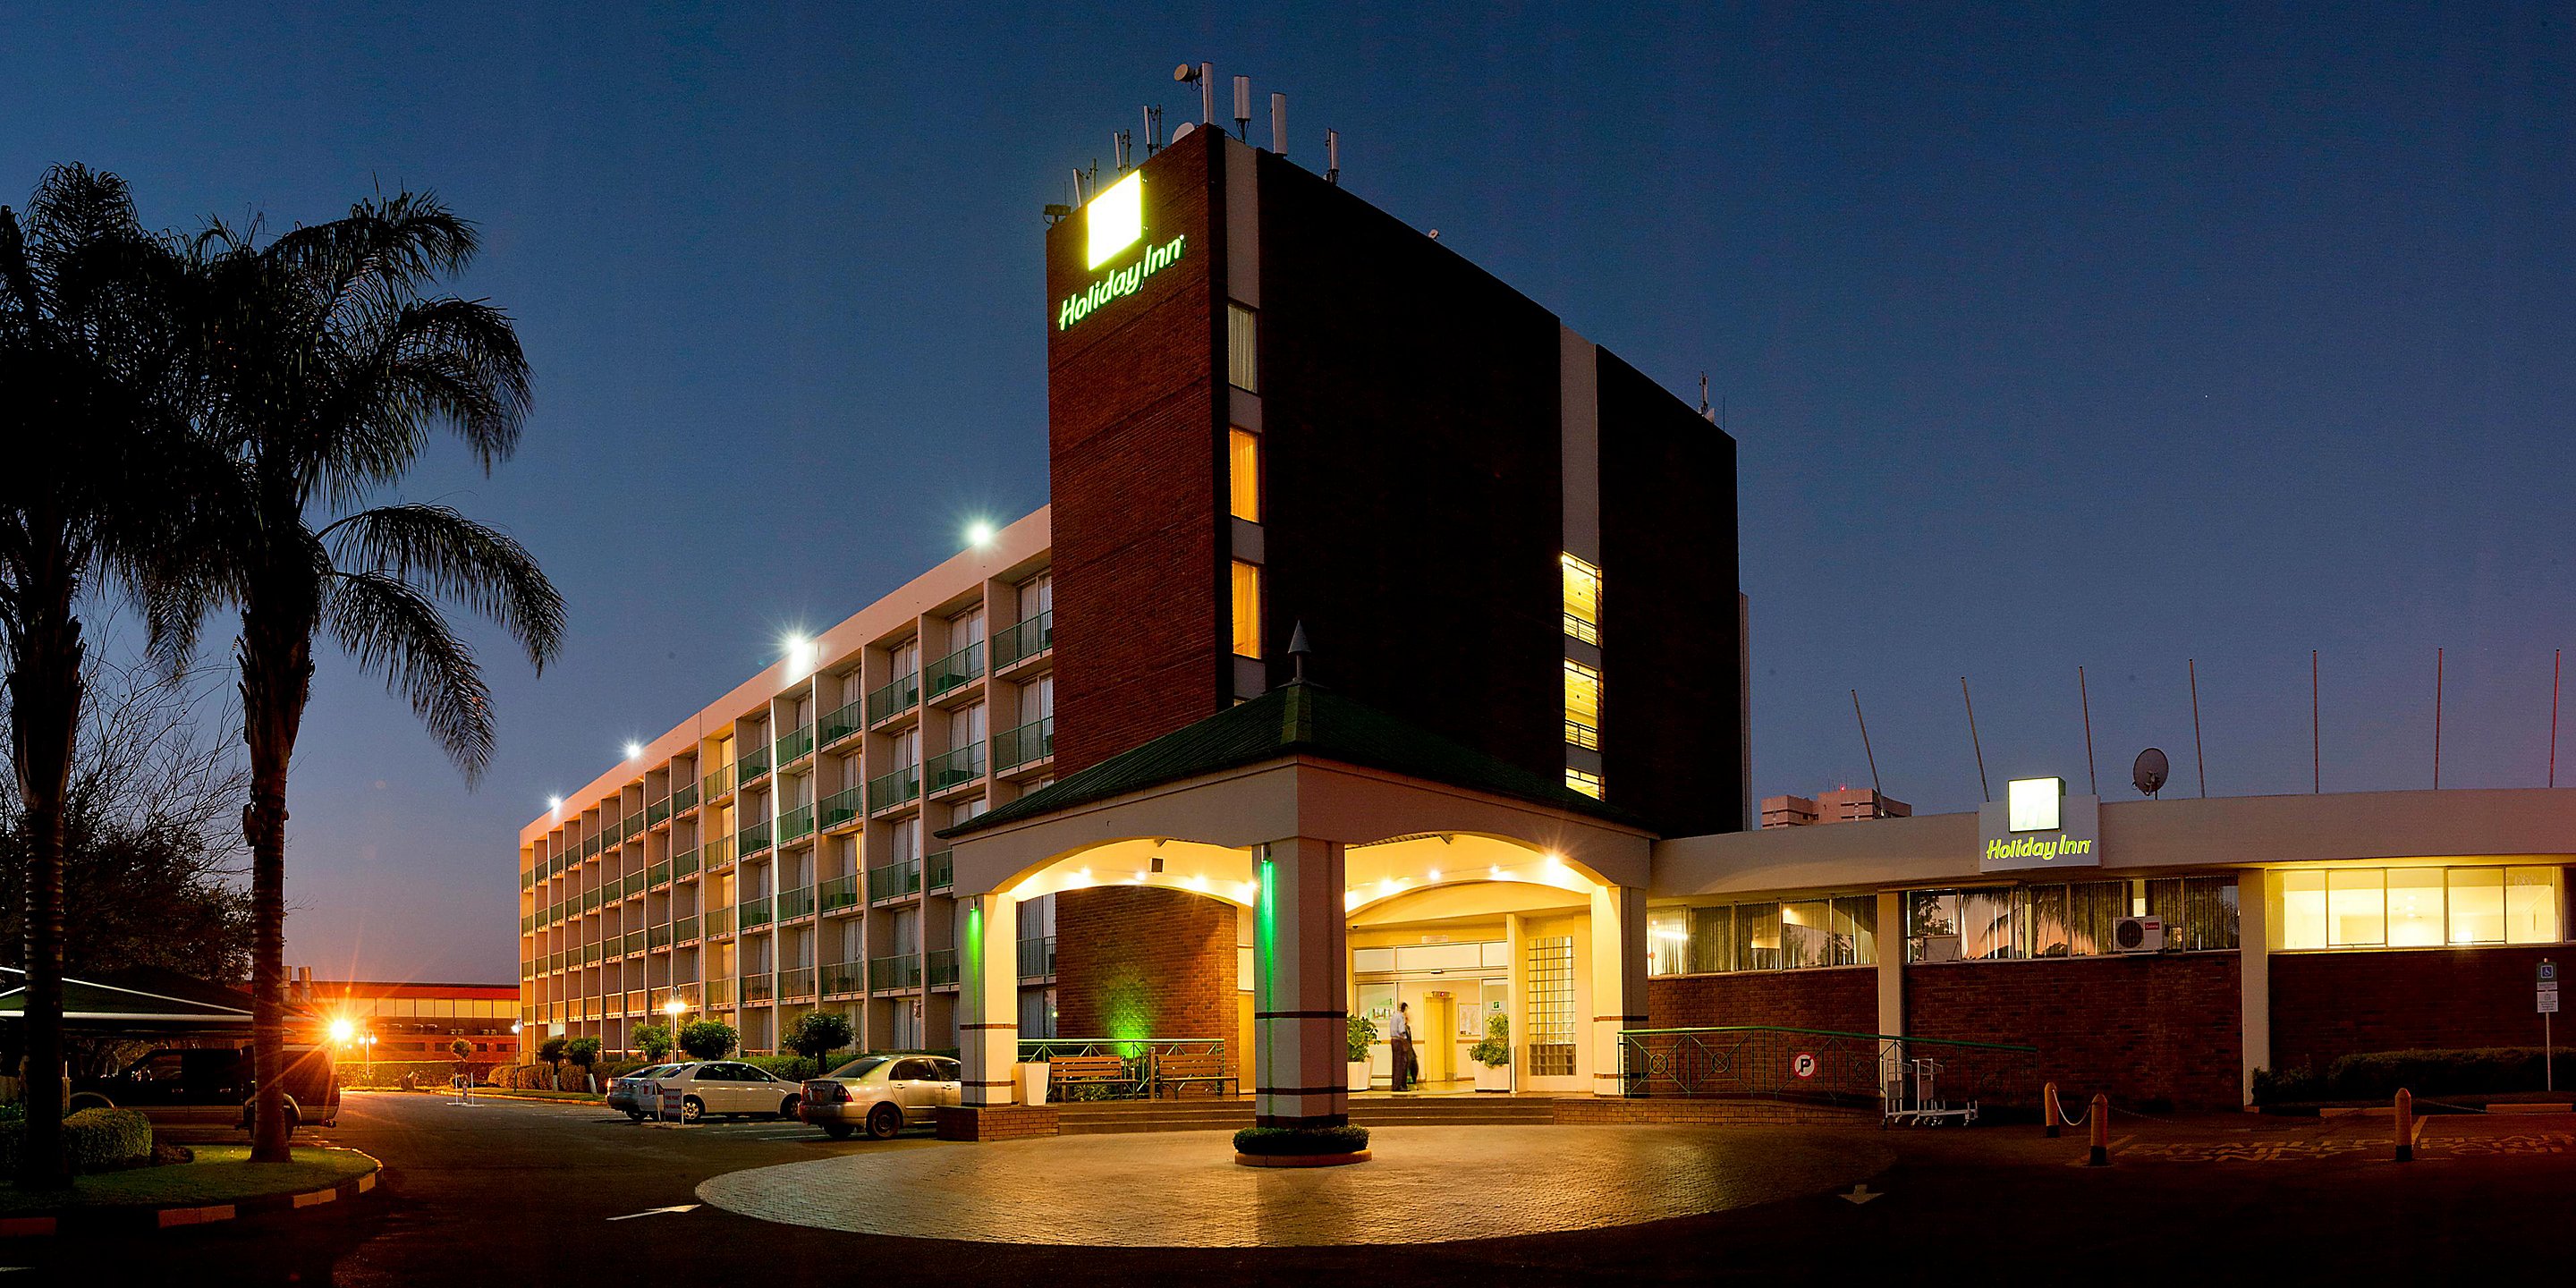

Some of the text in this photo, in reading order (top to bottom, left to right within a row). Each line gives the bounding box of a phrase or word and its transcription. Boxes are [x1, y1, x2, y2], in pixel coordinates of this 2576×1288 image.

[1058, 237, 1182, 331] Holiday Inn
[1986, 834, 2090, 860] Holiday Inn
[1800, 1058, 1811, 1072] P
